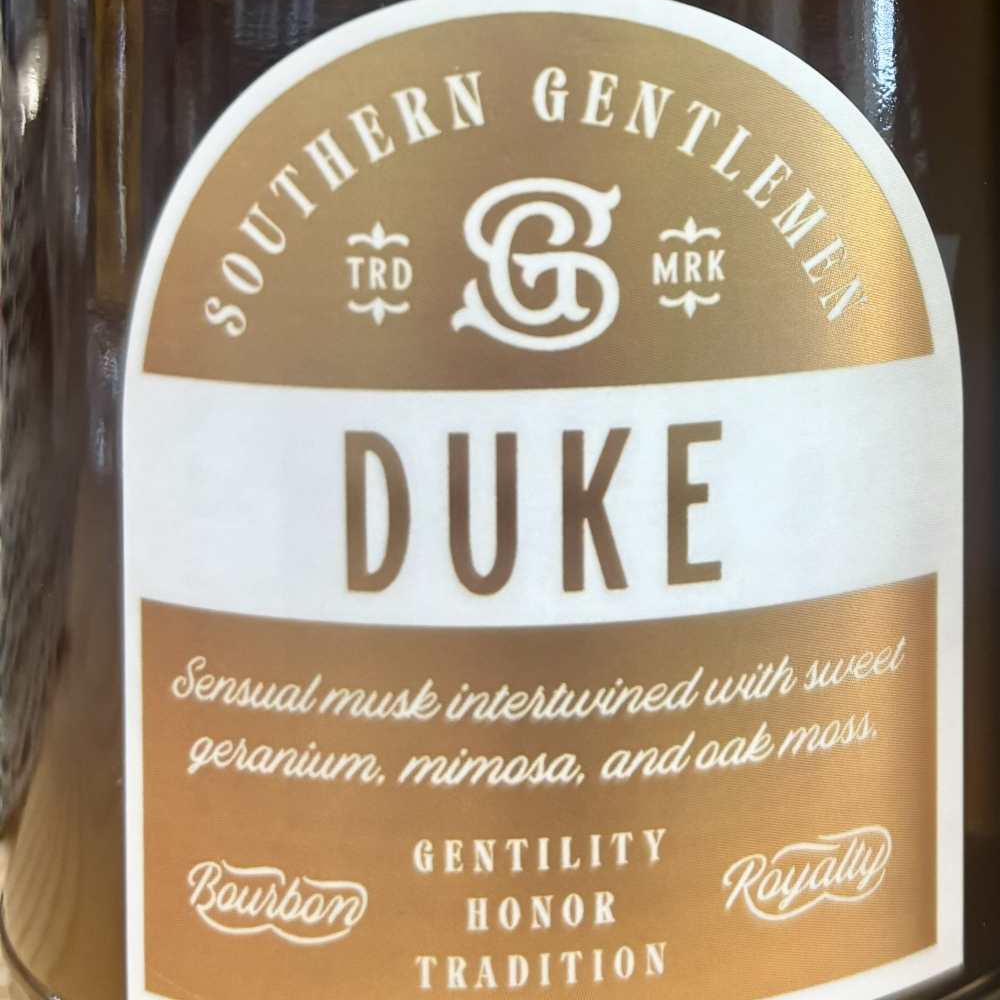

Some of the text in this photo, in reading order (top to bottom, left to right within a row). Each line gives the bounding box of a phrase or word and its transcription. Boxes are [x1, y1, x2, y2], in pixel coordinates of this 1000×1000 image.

[203, 65, 868, 338] SOUTHERN GENTLEMEN
[347, 256, 412, 292] TRD
[652, 249, 726, 285] MRK
[343, 420, 724, 596] DUKE
[171, 635, 907, 721] Sensual musk intertwined with sweet
[187, 711, 877, 786] geranium, mimosa, and oak moss.
[413, 828, 668, 873] GENTILITY
[723, 825, 892, 922] Royalty
[186, 859, 368, 943] Bourbon
[466, 890, 618, 932] HONOR
[415, 941, 668, 991] TRADITION
